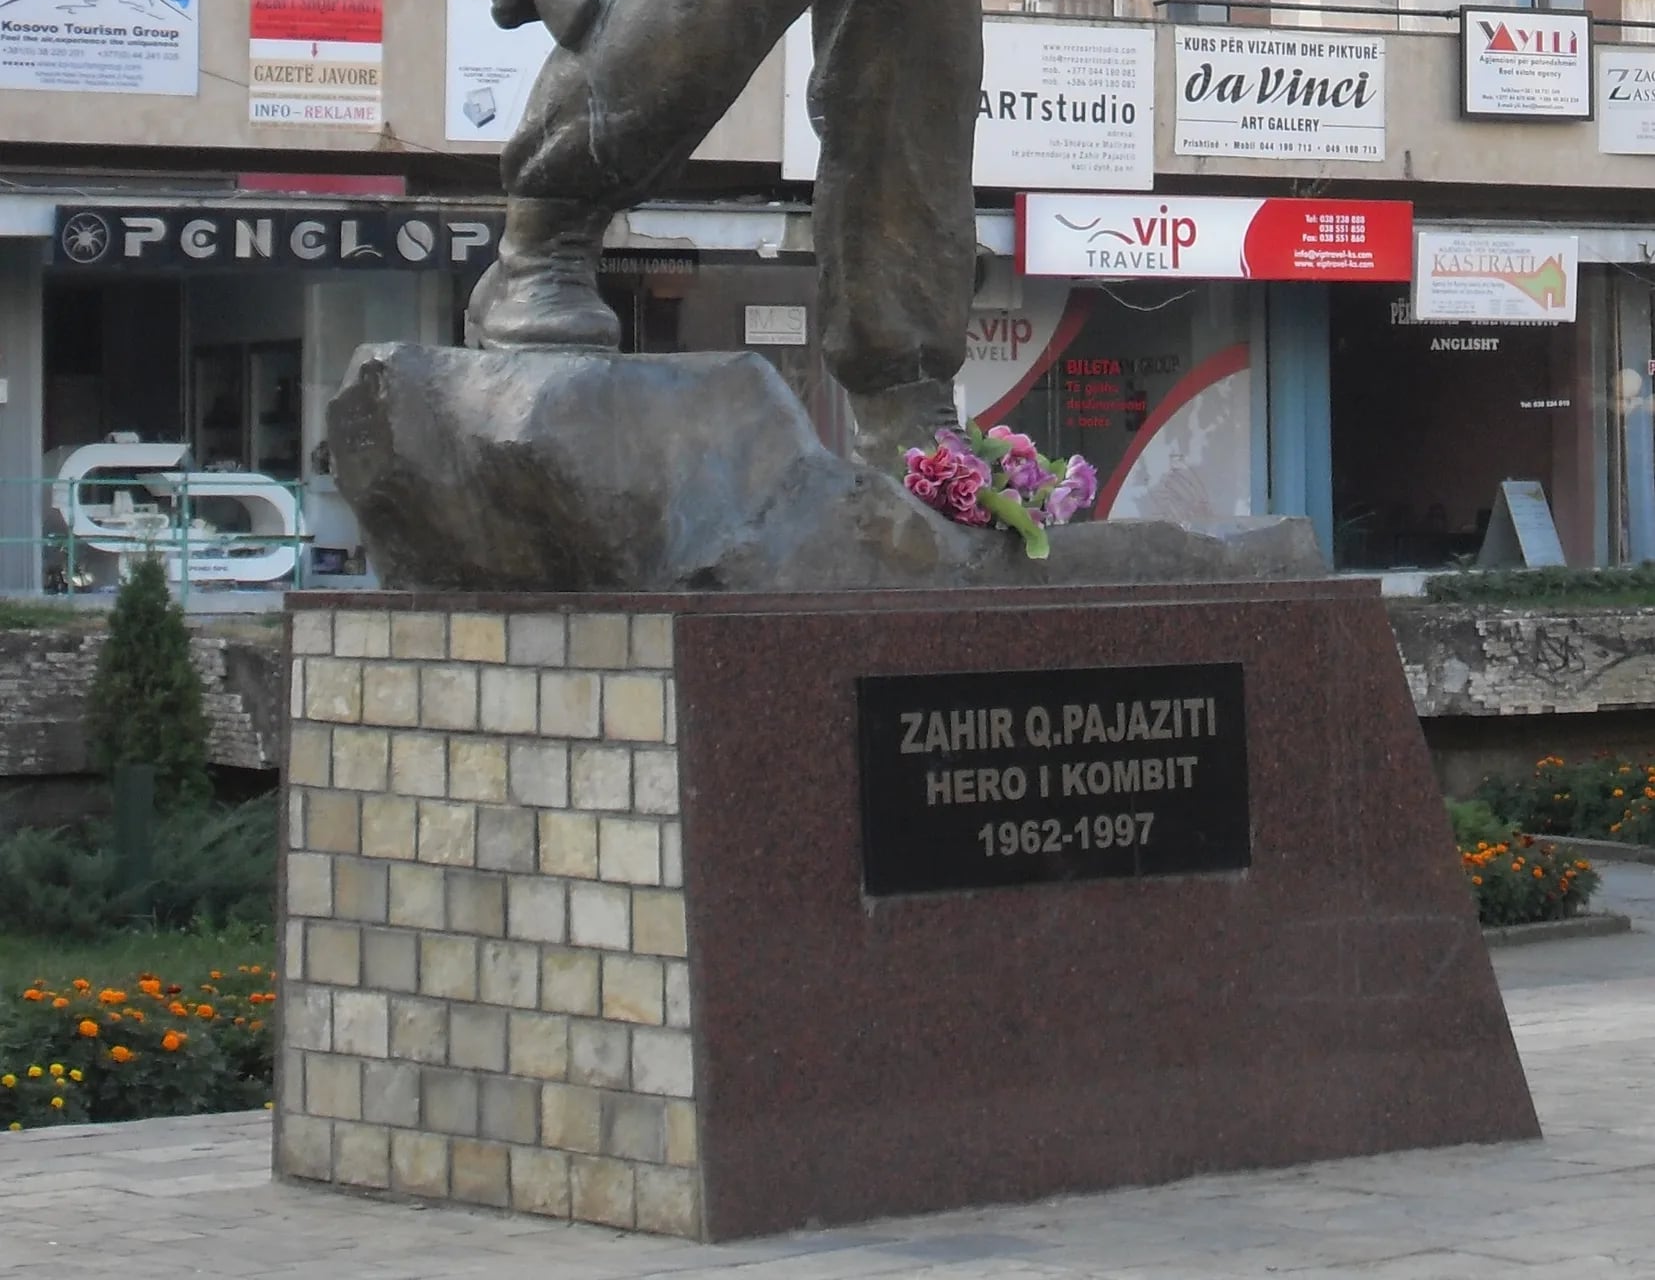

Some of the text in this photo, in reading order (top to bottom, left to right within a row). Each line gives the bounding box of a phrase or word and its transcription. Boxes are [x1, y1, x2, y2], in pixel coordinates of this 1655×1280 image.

[1, 20, 179, 40] Kosovo Tourism Group
[1184, 37, 1378, 59] KURS PËR VIZATIM DHE PIKTURË
[254, 64, 377, 85] GAZETË JAVORE
[1184, 63, 1377, 109] da Vinci
[255, 104, 290, 118] INFO
[304, 106, 374, 120] REKLAME
[1241, 116, 1320, 132] ART GALLERY
[1259, 142, 1274, 151] 044
[1305, 214, 1318, 223] Tel:
[1319, 214, 1334, 224] 038
[1319, 224, 1334, 233] 038
[1335, 224, 1348, 233] 551
[1132, 204, 1197, 269] vip
[1302, 233, 1318, 242] Fax:
[1319, 234, 1334, 242] 038
[1335, 234, 1348, 242] 551
[597, 257, 693, 274] SHION LONDON
[1086, 250, 1169, 269] TRAVEL
[1433, 253, 1536, 272] KASTRATI
[980, 311, 1032, 360] vip
[1430, 338, 1500, 351] ANGLISHT
[900, 698, 1216, 754] ZAHIR Q.PAJAZITI
[927, 756, 1199, 805] HERO I KOMBIT
[978, 812, 1155, 856] 1962-1997
